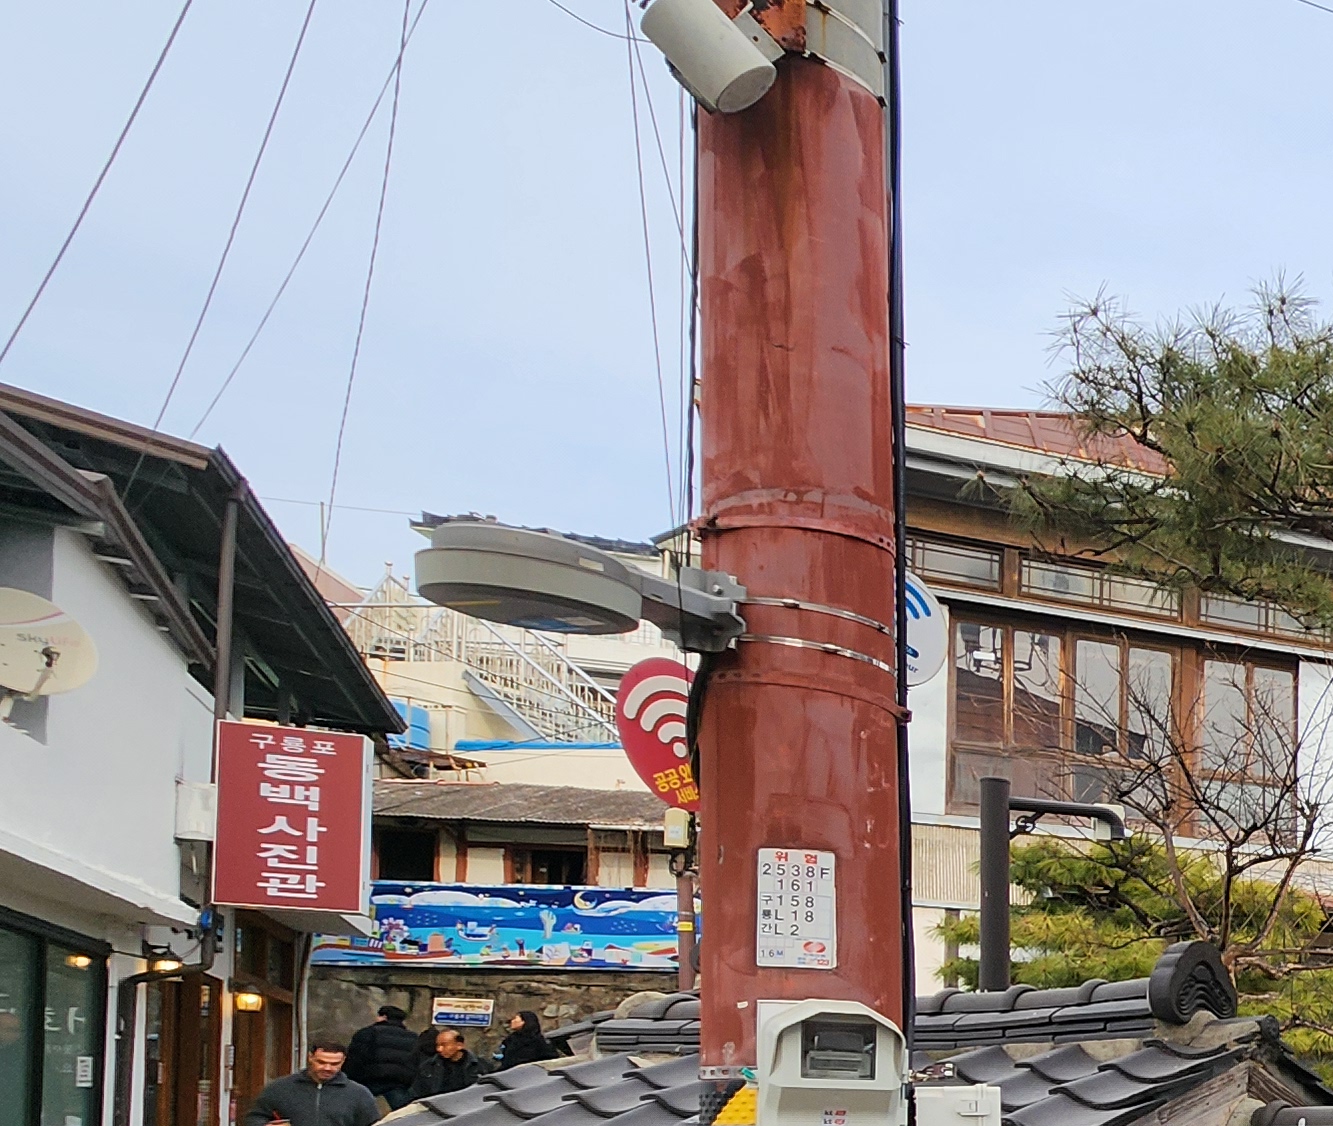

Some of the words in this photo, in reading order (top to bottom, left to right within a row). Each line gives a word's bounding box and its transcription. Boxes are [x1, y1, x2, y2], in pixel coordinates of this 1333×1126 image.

[248, 732, 337, 756] 구룡포
[256, 753, 328, 899] 동백사진관
[762, 863, 831, 879] 2538F
[777, 879, 813, 892] 161
